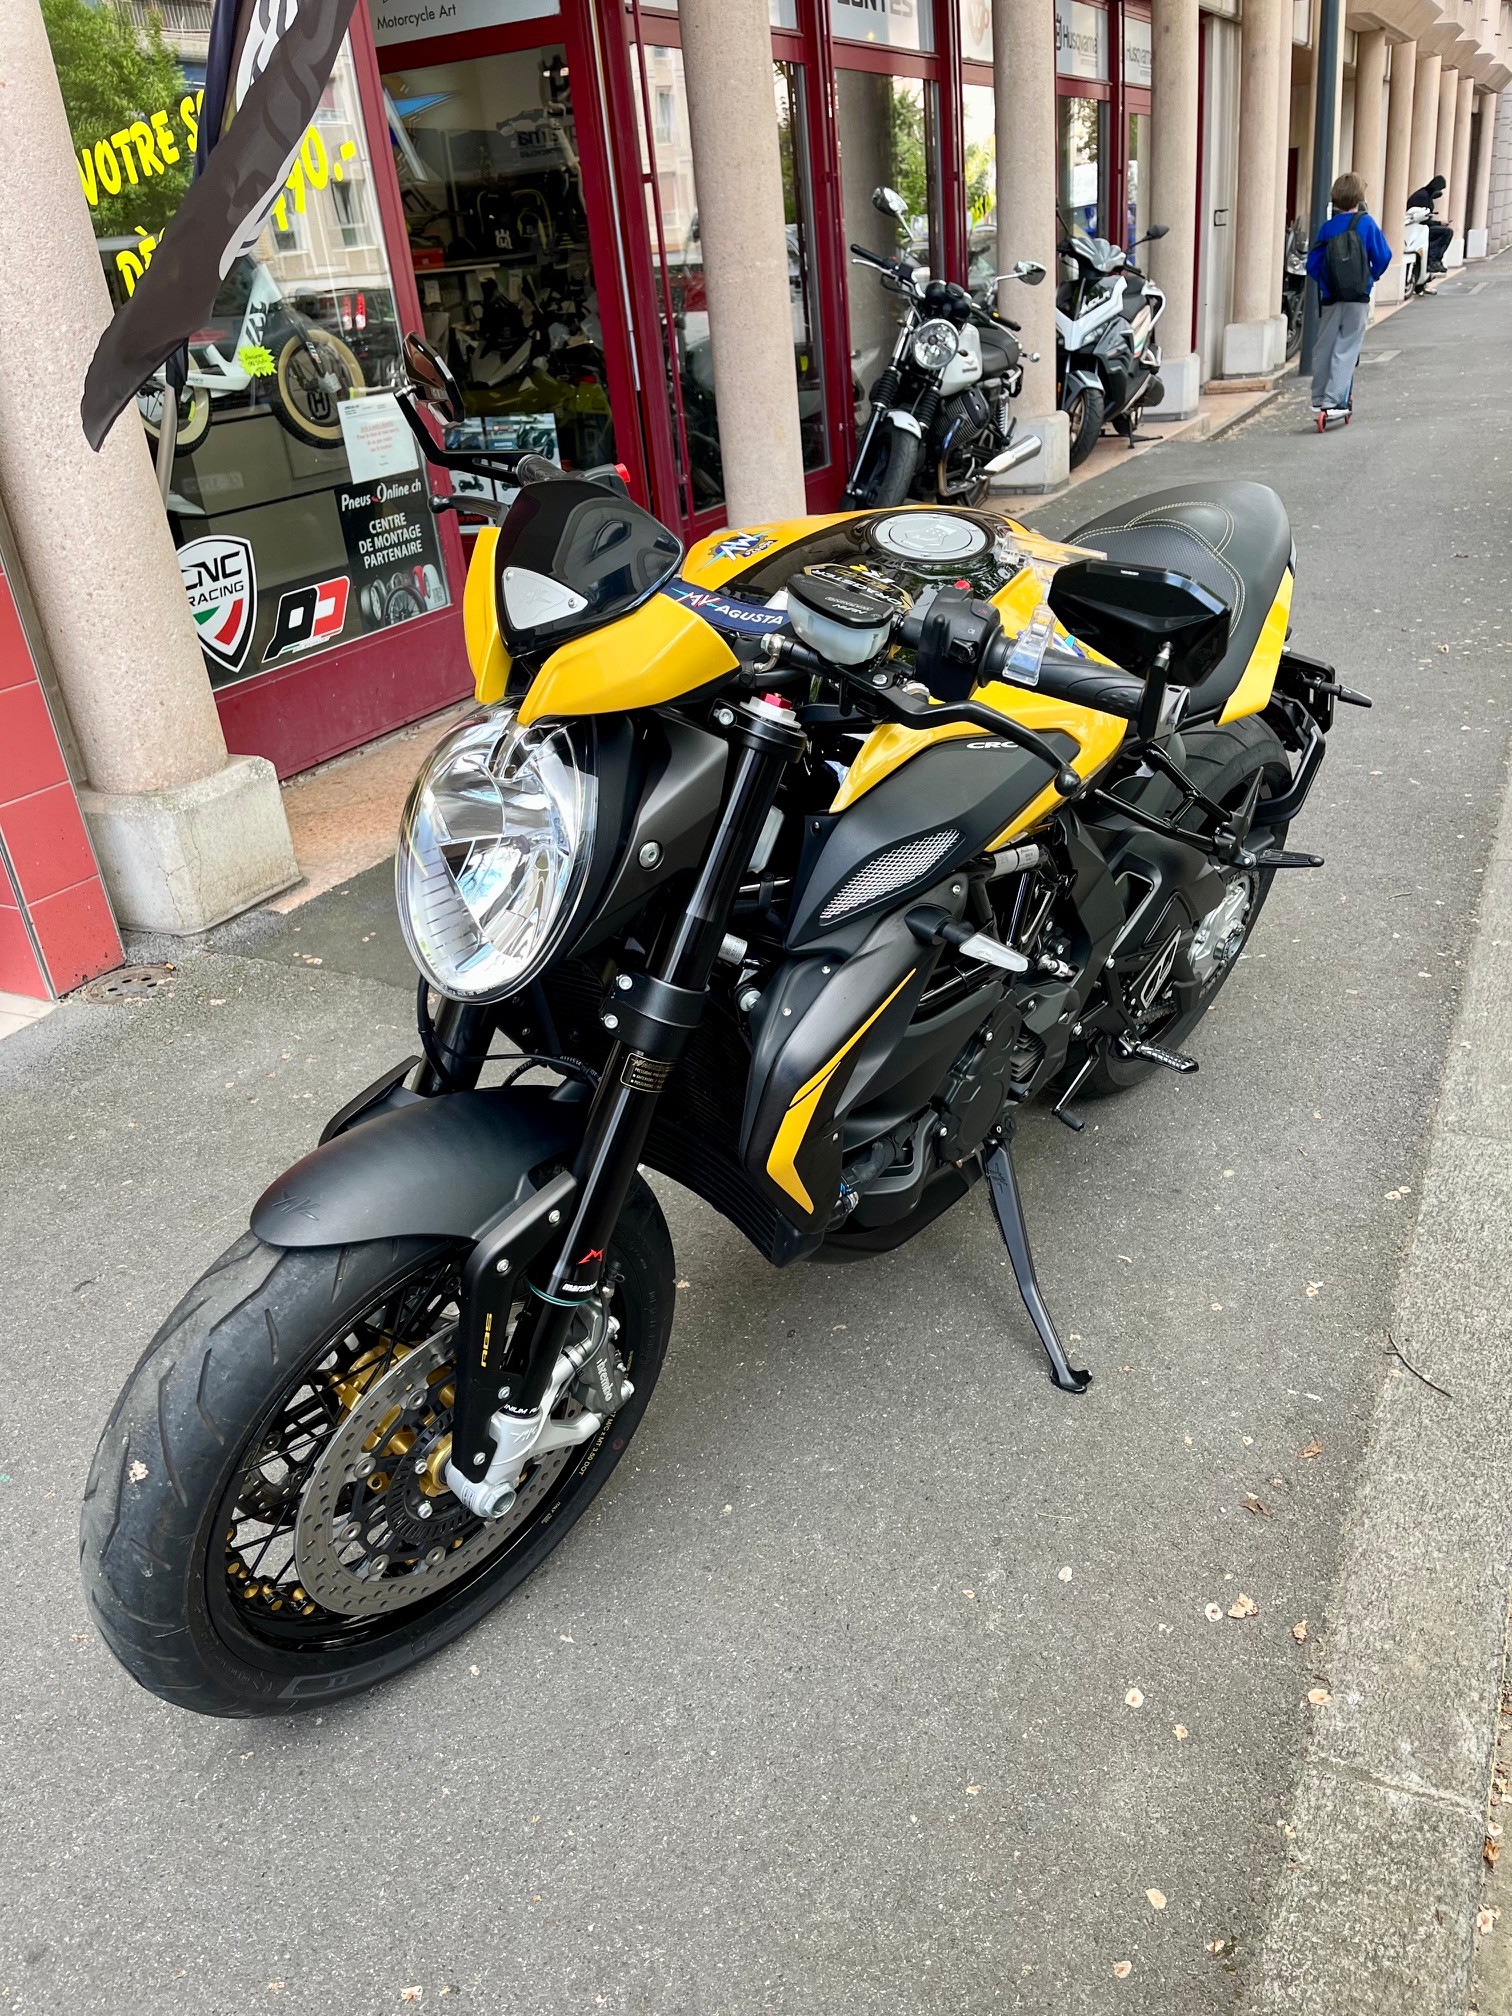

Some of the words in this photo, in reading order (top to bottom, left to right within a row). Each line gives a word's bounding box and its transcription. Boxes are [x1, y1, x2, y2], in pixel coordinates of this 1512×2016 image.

[377, 6, 435, 30] Motorcycle
[439, 4, 456, 19] Art
[1063, 24, 1098, 55] Husqvarna
[75, 109, 180, 206] VOTRE
[180, 89, 205, 153] S
[369, 512, 407, 535] CENTRE
[358, 537, 375, 554] DE
[374, 523, 422, 551] MONTAGE
[363, 540, 424, 570] PARTENAIRE
[188, 580, 244, 607] RACING
[715, 605, 784, 625] AGUSTA
[966, 741, 1019, 749] CRC
[597, 1358, 614, 1402] brembo
[596, 1436, 605, 1447] MT
[579, 1460, 592, 1477] DOT
